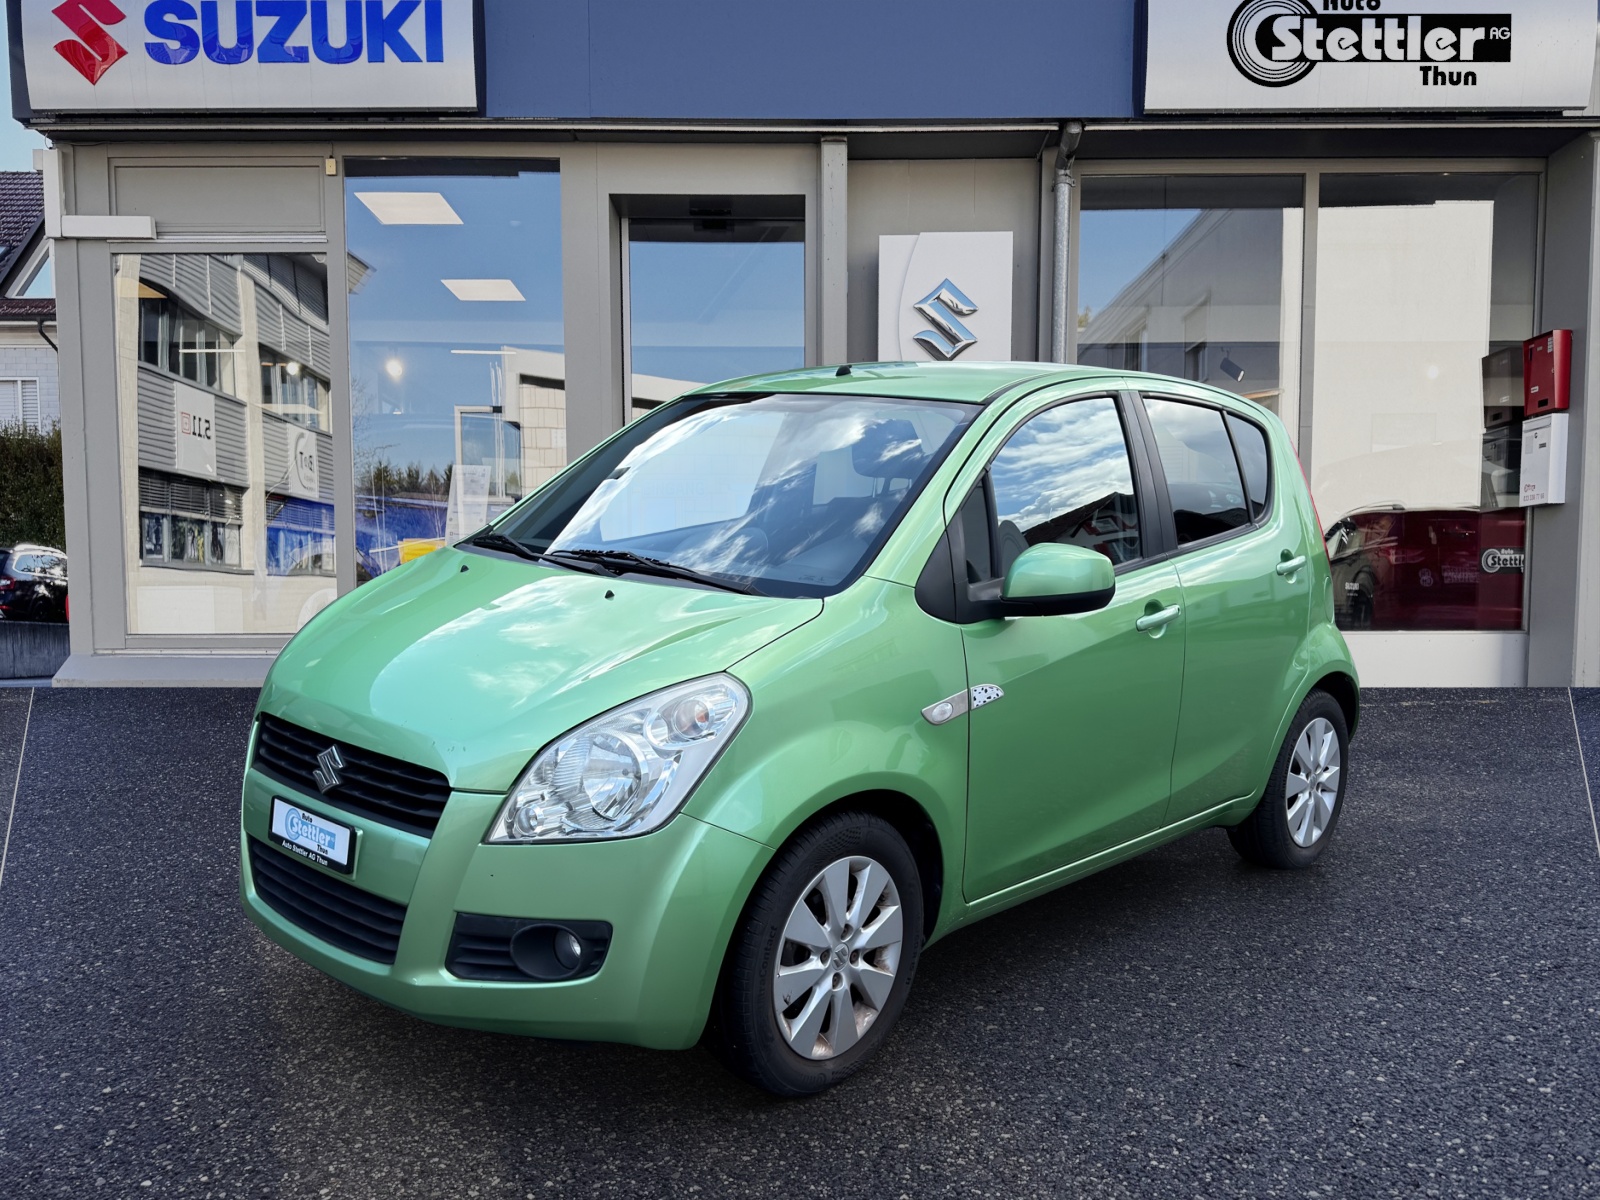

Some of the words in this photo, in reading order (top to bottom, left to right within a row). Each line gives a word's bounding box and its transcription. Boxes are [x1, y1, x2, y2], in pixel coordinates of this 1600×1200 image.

[144, 0, 444, 64] SUZUKI
[1272, 16, 1485, 61] Stettler
[1489, 26, 1511, 41] AG
[1419, 65, 1477, 86] Thun
[302, 813, 312, 823] Auto
[292, 818, 330, 846] Stettler
[282, 840, 291, 849] Auto
[292, 845, 307, 856] Stettler
[317, 856, 327, 865] Thun
[317, 844, 328, 855] Thun
